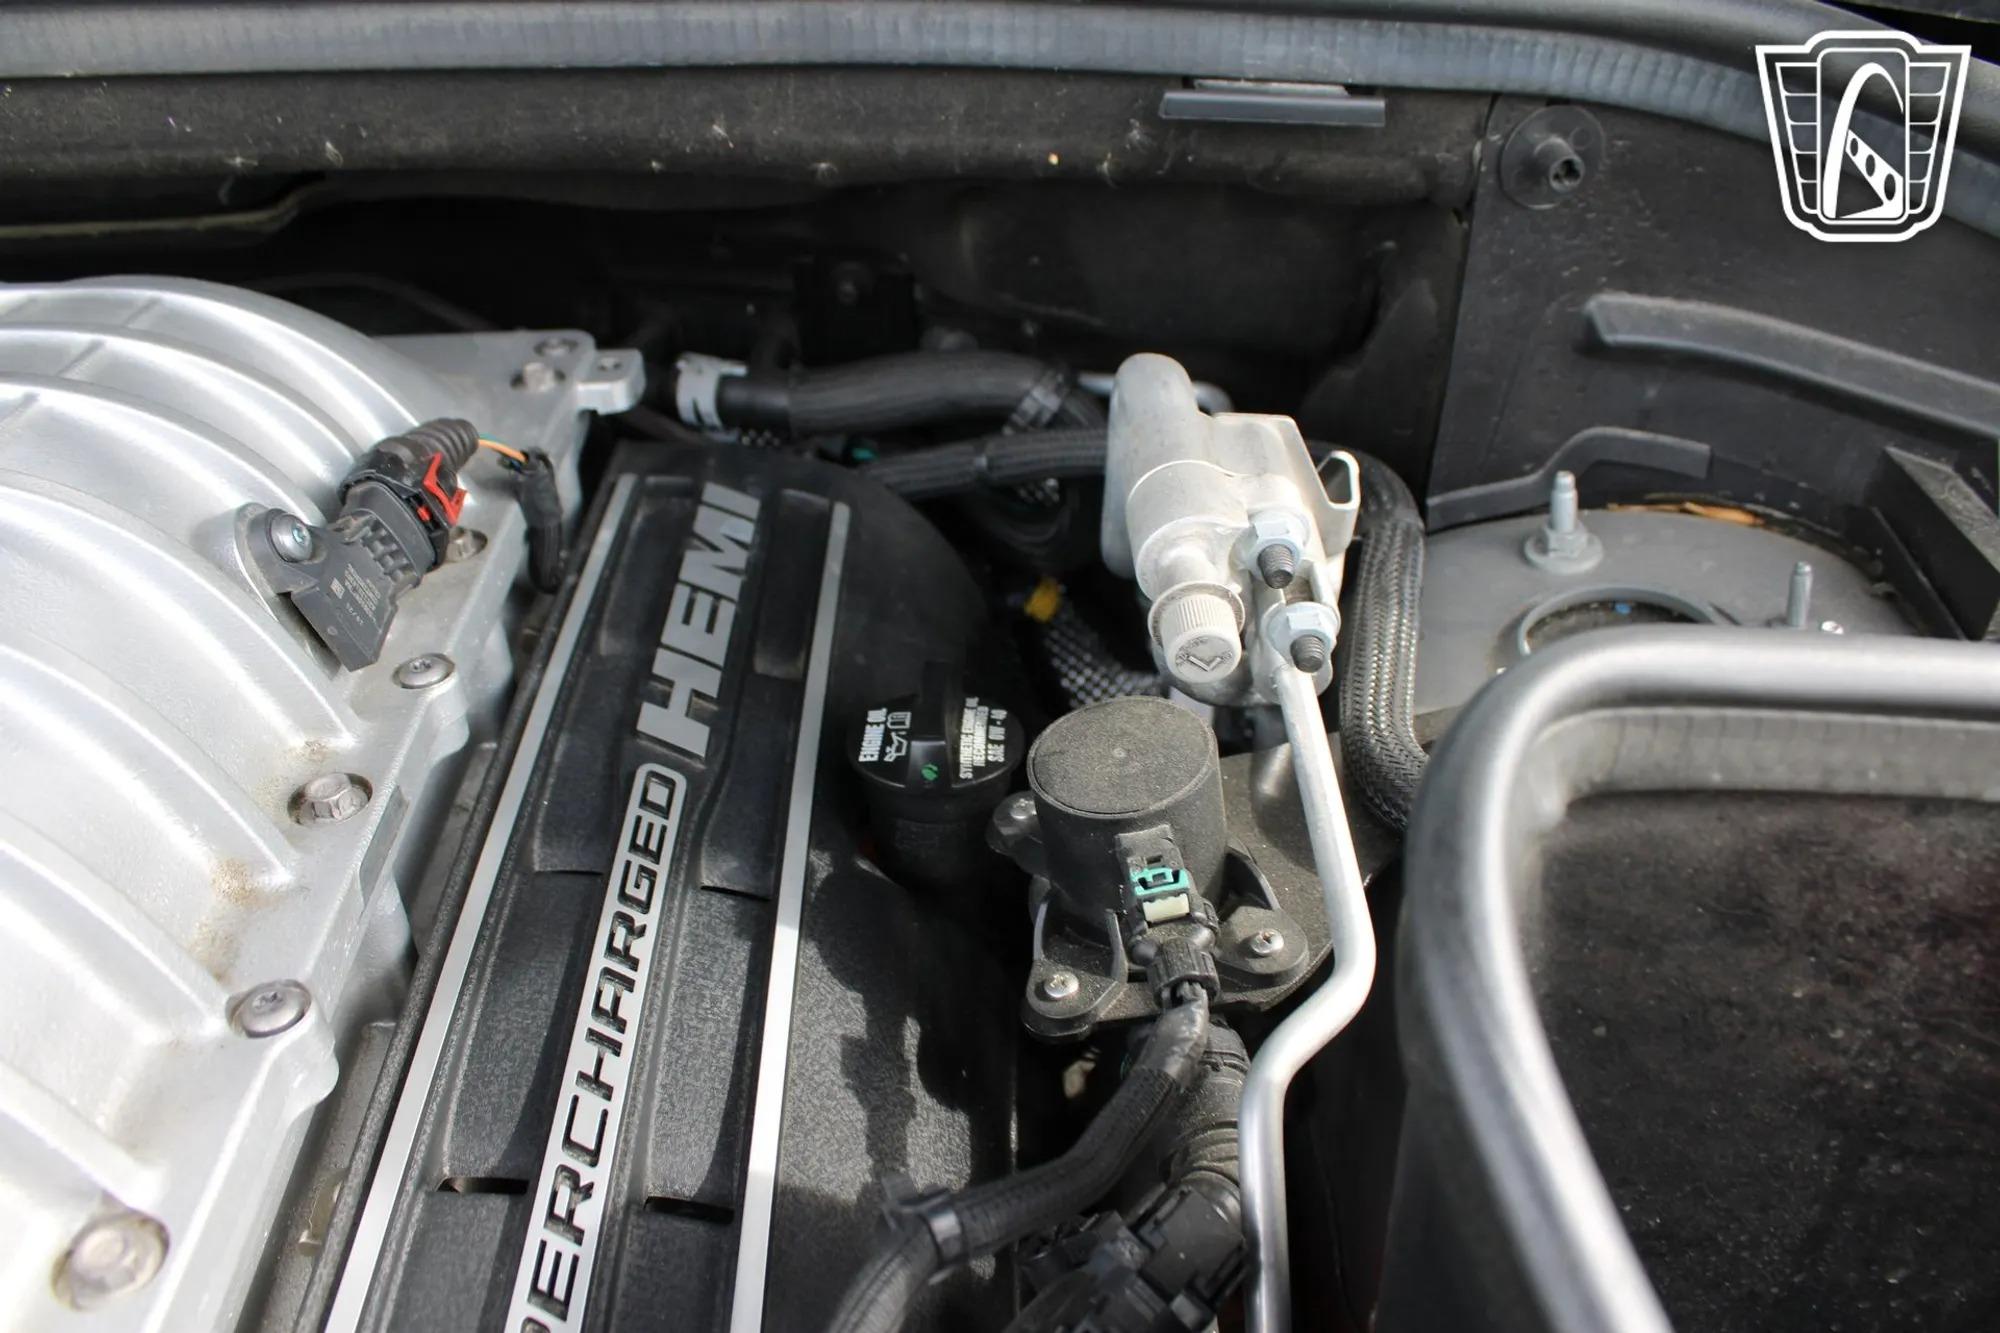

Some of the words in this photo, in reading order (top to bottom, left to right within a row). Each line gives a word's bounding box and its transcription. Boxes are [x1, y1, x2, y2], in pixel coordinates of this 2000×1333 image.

[636, 484, 760, 760] HEMI
[866, 707, 888, 723] OIL
[858, 722, 885, 762] ENGINE
[959, 733, 974, 779] SYNTHETIC
[987, 743, 1005, 763] SAE
[520, 771, 679, 1333] ERCHARGED
